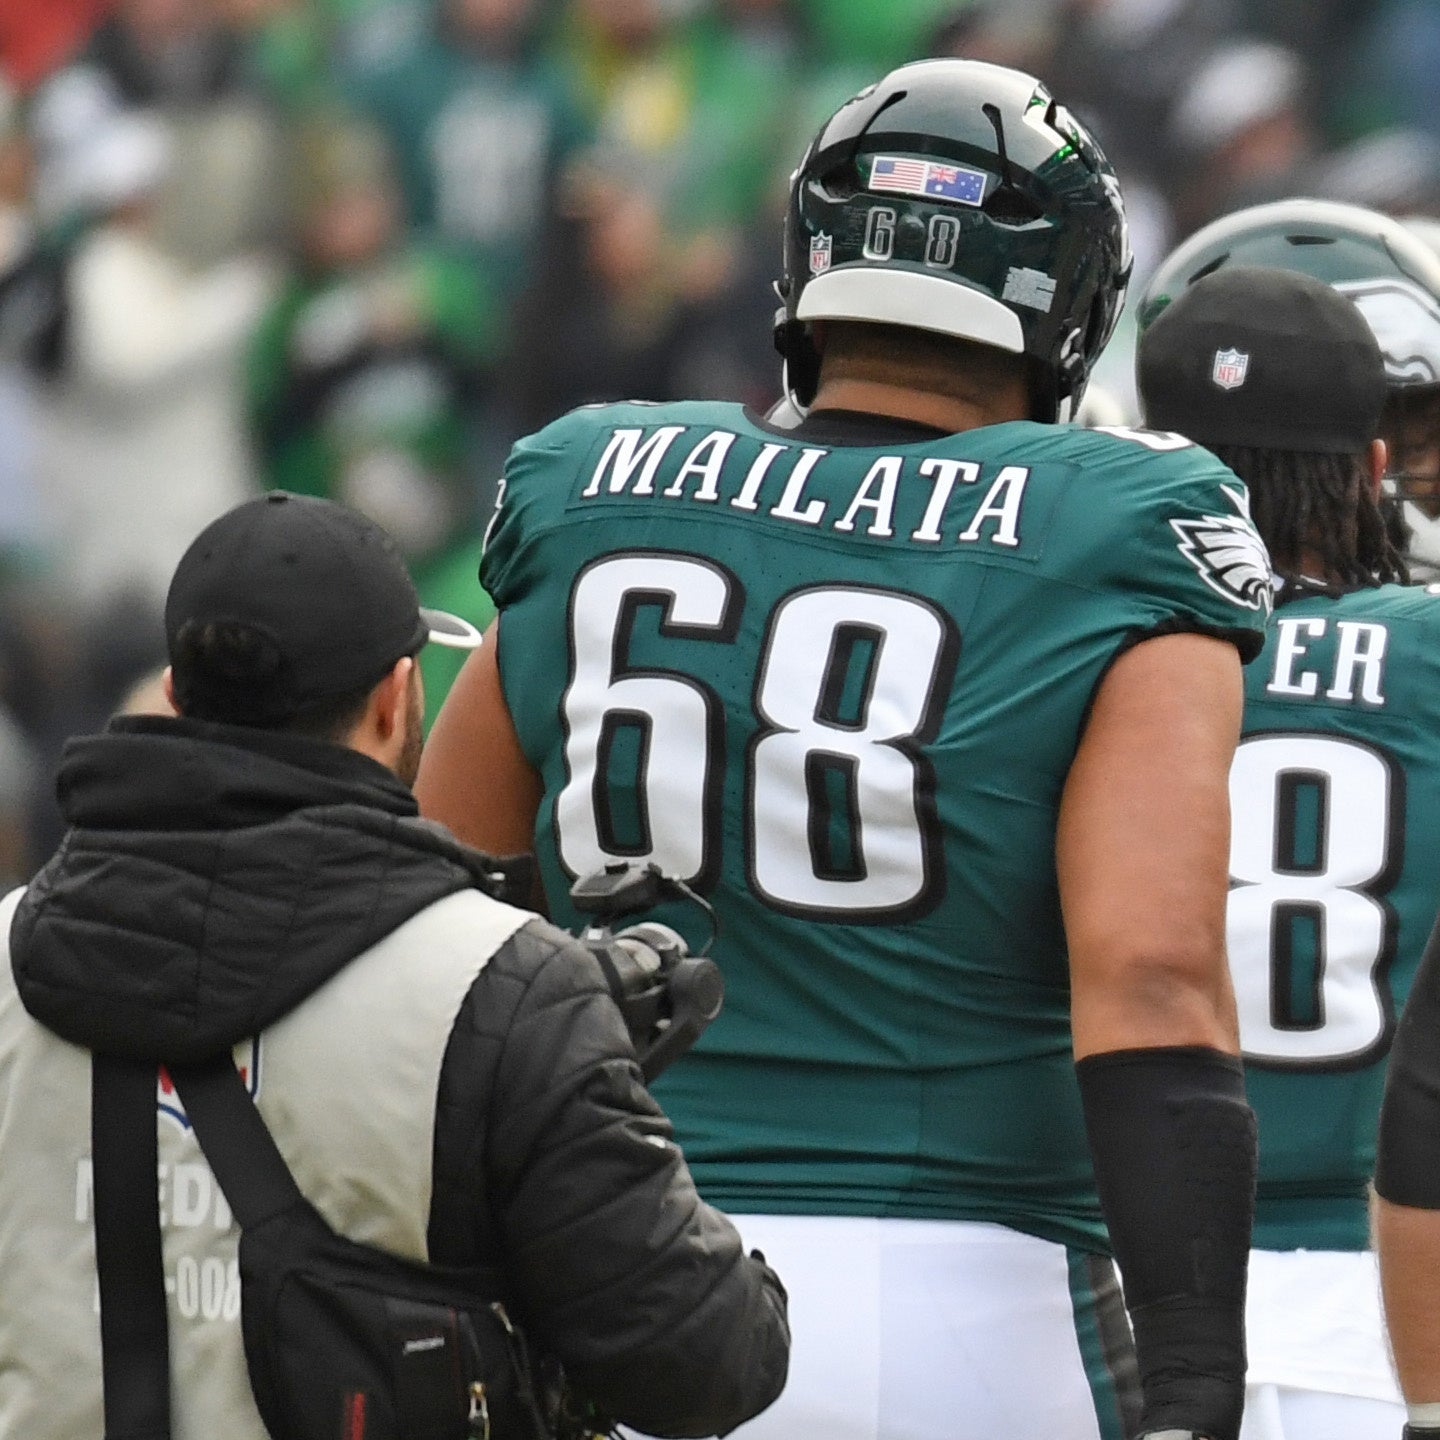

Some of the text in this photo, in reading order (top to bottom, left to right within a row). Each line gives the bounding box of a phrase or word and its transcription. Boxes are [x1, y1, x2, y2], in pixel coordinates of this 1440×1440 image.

[862, 205, 961, 271] 68
[582, 424, 1032, 548] MAILATA
[1265, 616, 1388, 705] ER
[555, 553, 948, 913] 68
